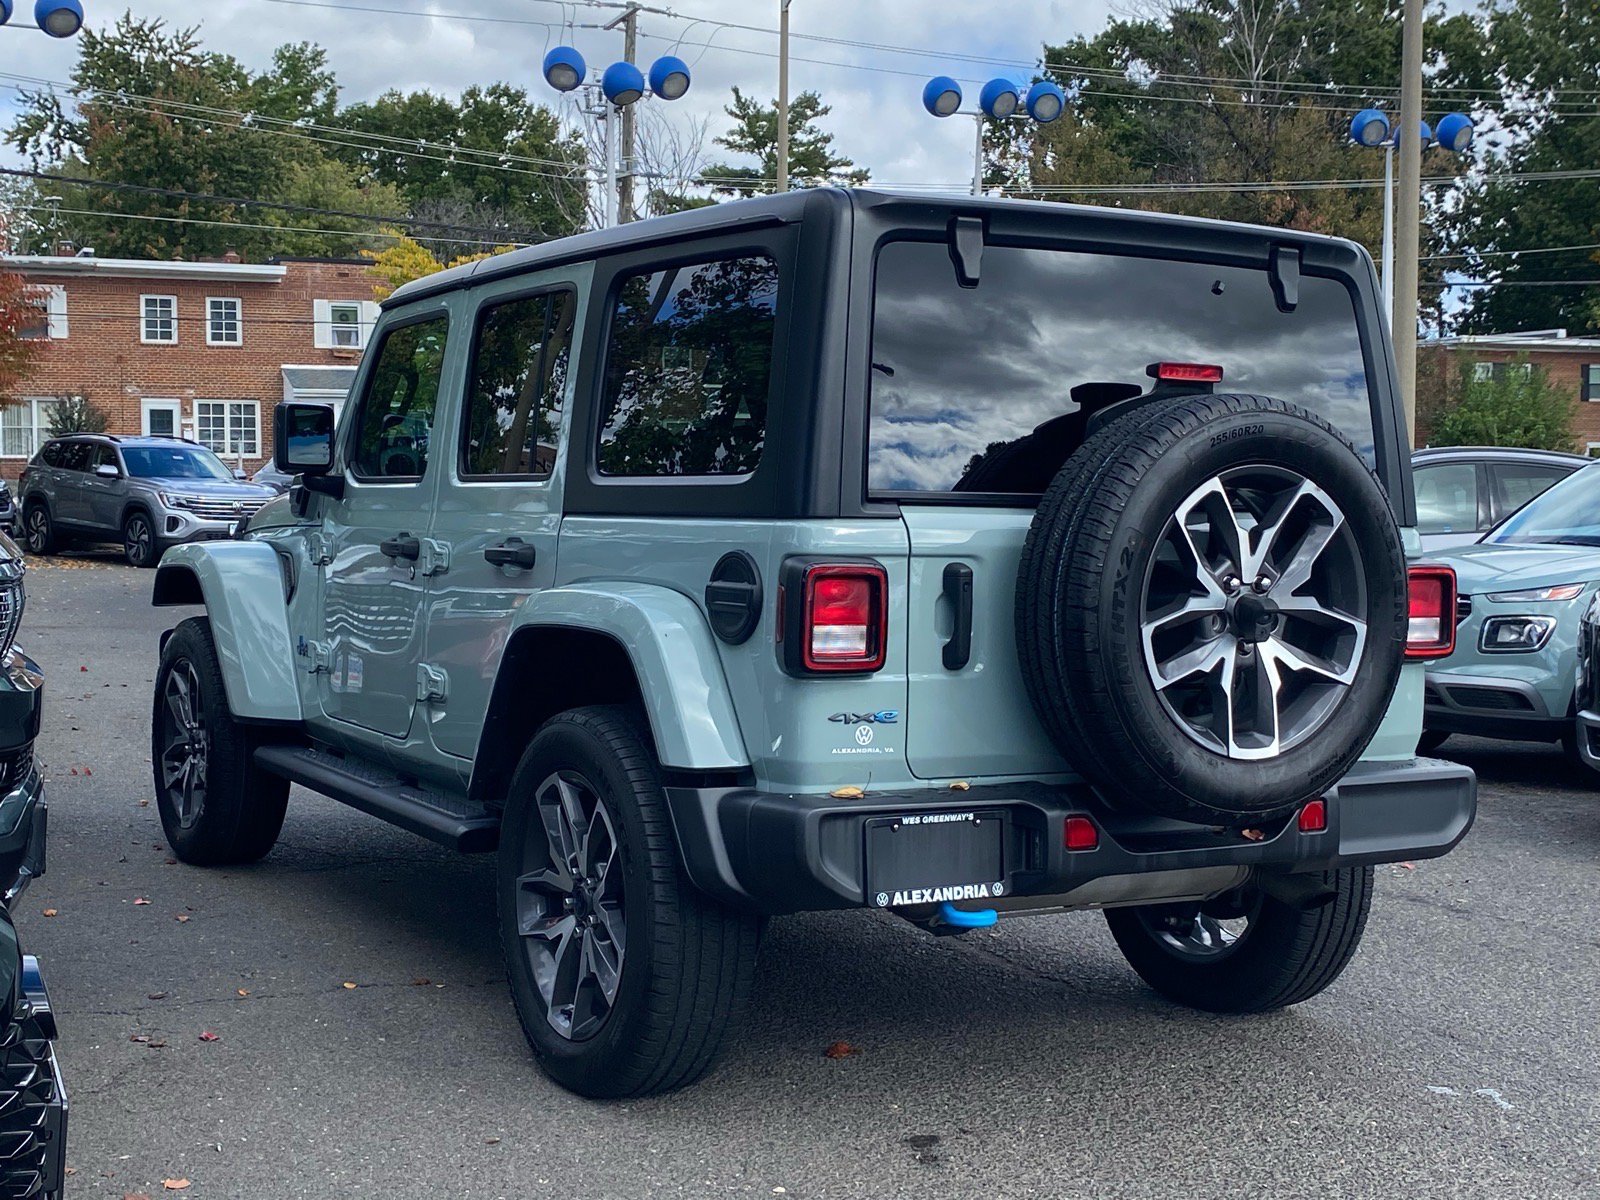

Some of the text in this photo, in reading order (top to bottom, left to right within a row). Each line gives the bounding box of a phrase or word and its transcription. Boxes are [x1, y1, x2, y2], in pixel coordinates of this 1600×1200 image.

[1209, 424, 1264, 448] 255/60R20
[902, 813, 974, 825] WES GREENWAY'S
[892, 884, 989, 905] ALEXANDRIA
